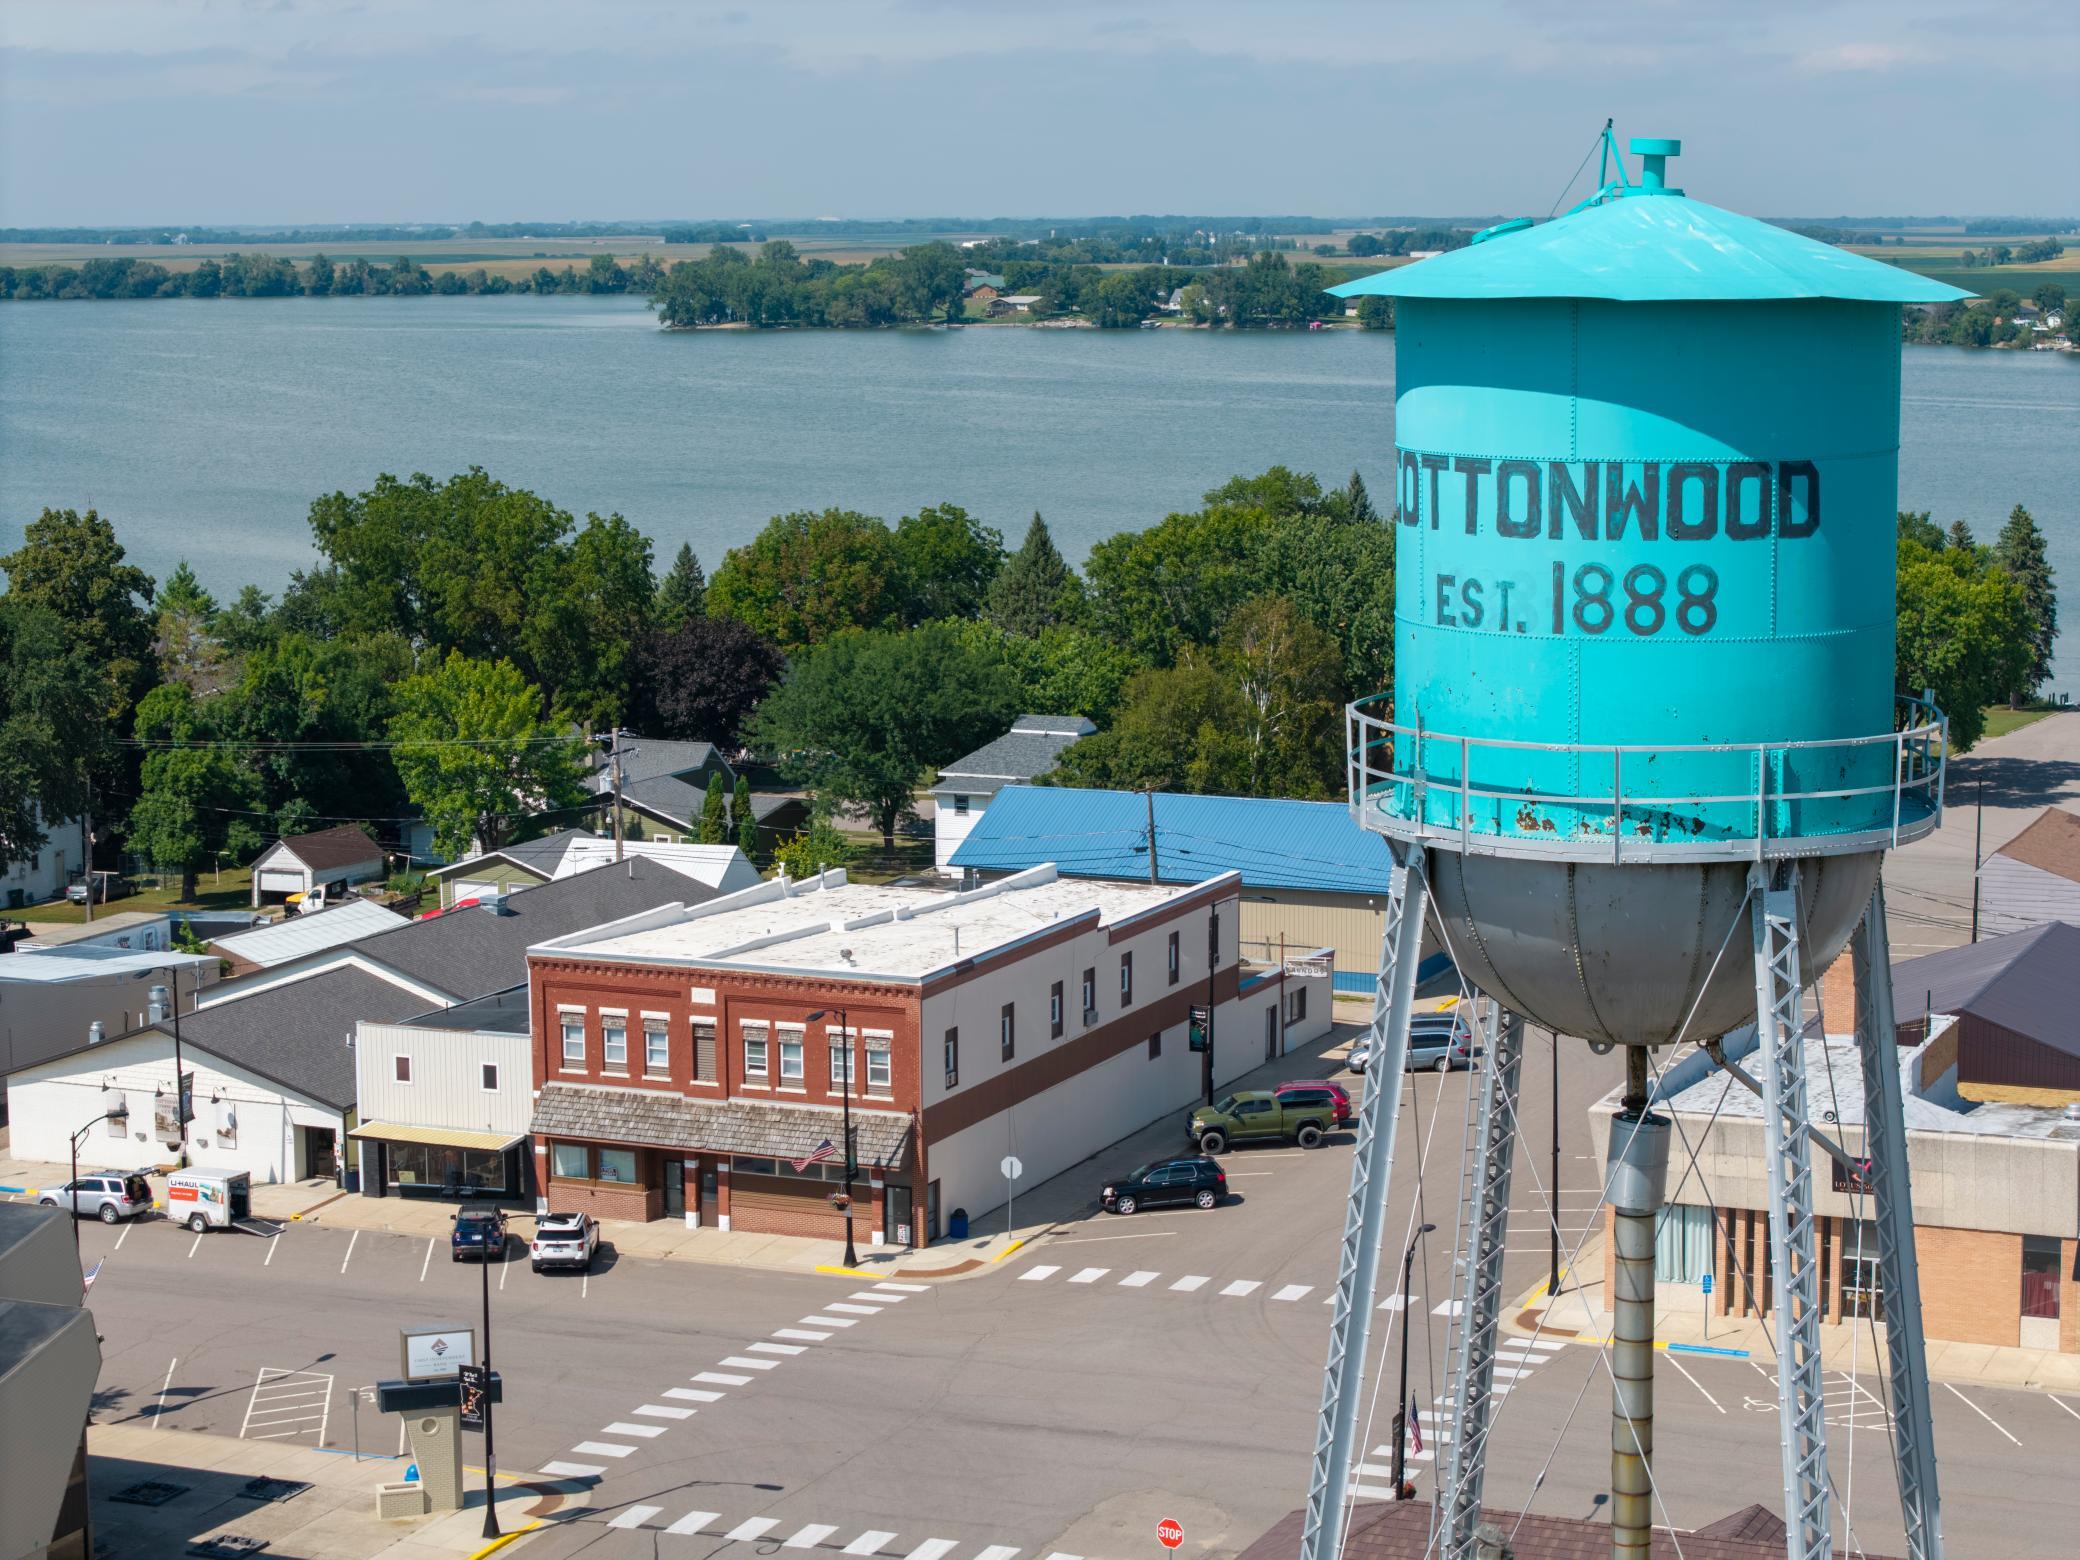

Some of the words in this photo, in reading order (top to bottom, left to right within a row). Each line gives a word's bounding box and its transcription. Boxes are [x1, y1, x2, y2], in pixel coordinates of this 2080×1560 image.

[1396, 449, 1821, 541] OTTONWOOD
[1436, 573, 1527, 633] EST.
[1551, 561, 1719, 636] 1888
[170, 1179, 199, 1188] U-HAUL
[1158, 1526, 1182, 1541] STOP
